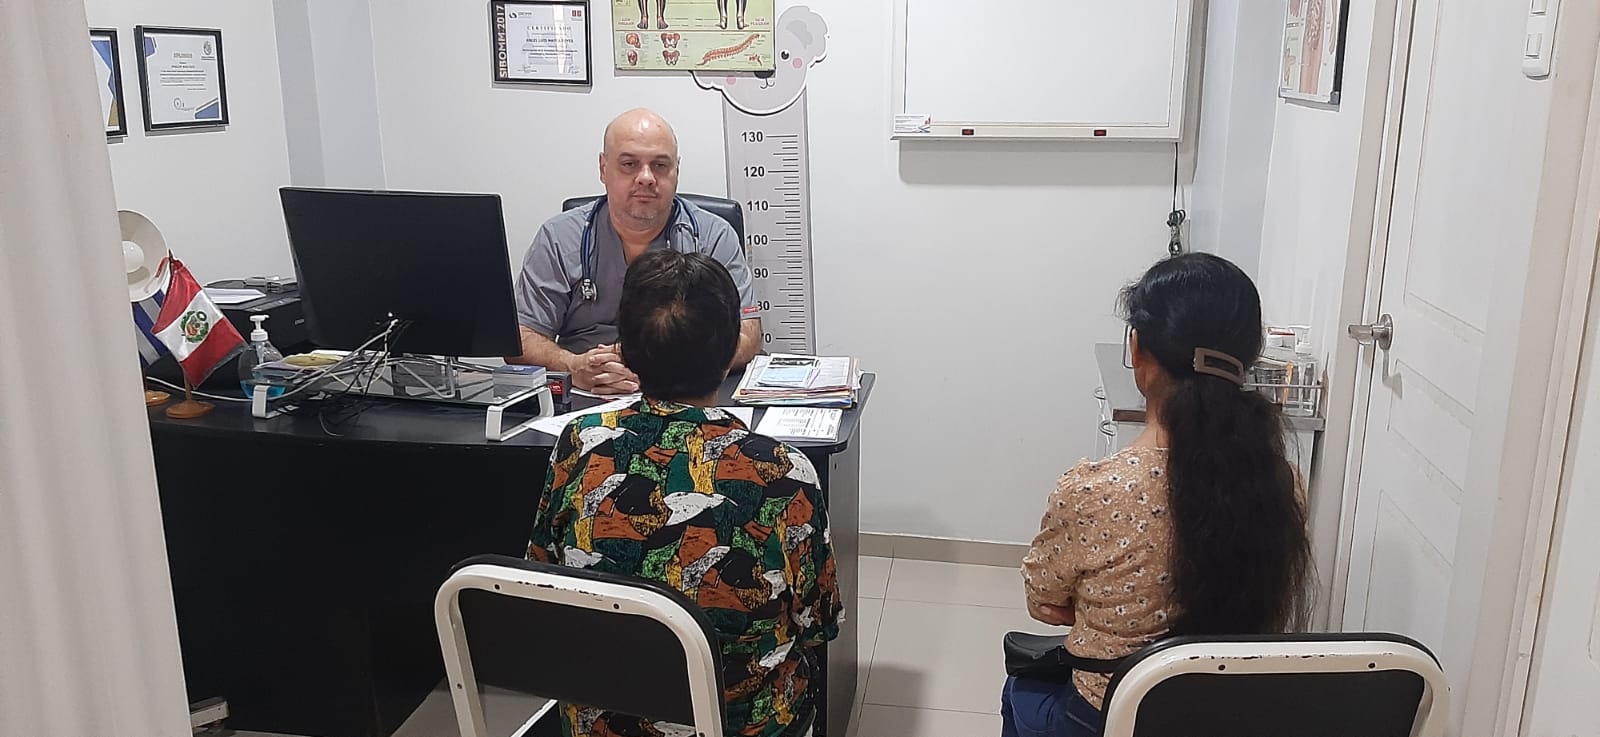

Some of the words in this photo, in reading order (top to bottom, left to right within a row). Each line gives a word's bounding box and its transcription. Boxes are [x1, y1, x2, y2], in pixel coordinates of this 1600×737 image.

[496, 5, 505, 30] 2017
[741, 131, 764, 143] 130
[743, 166, 765, 178] 120
[746, 201, 769, 211] 110
[747, 235, 768, 246] 100
[754, 268, 769, 279] 90
[761, 333, 772, 343] 0
